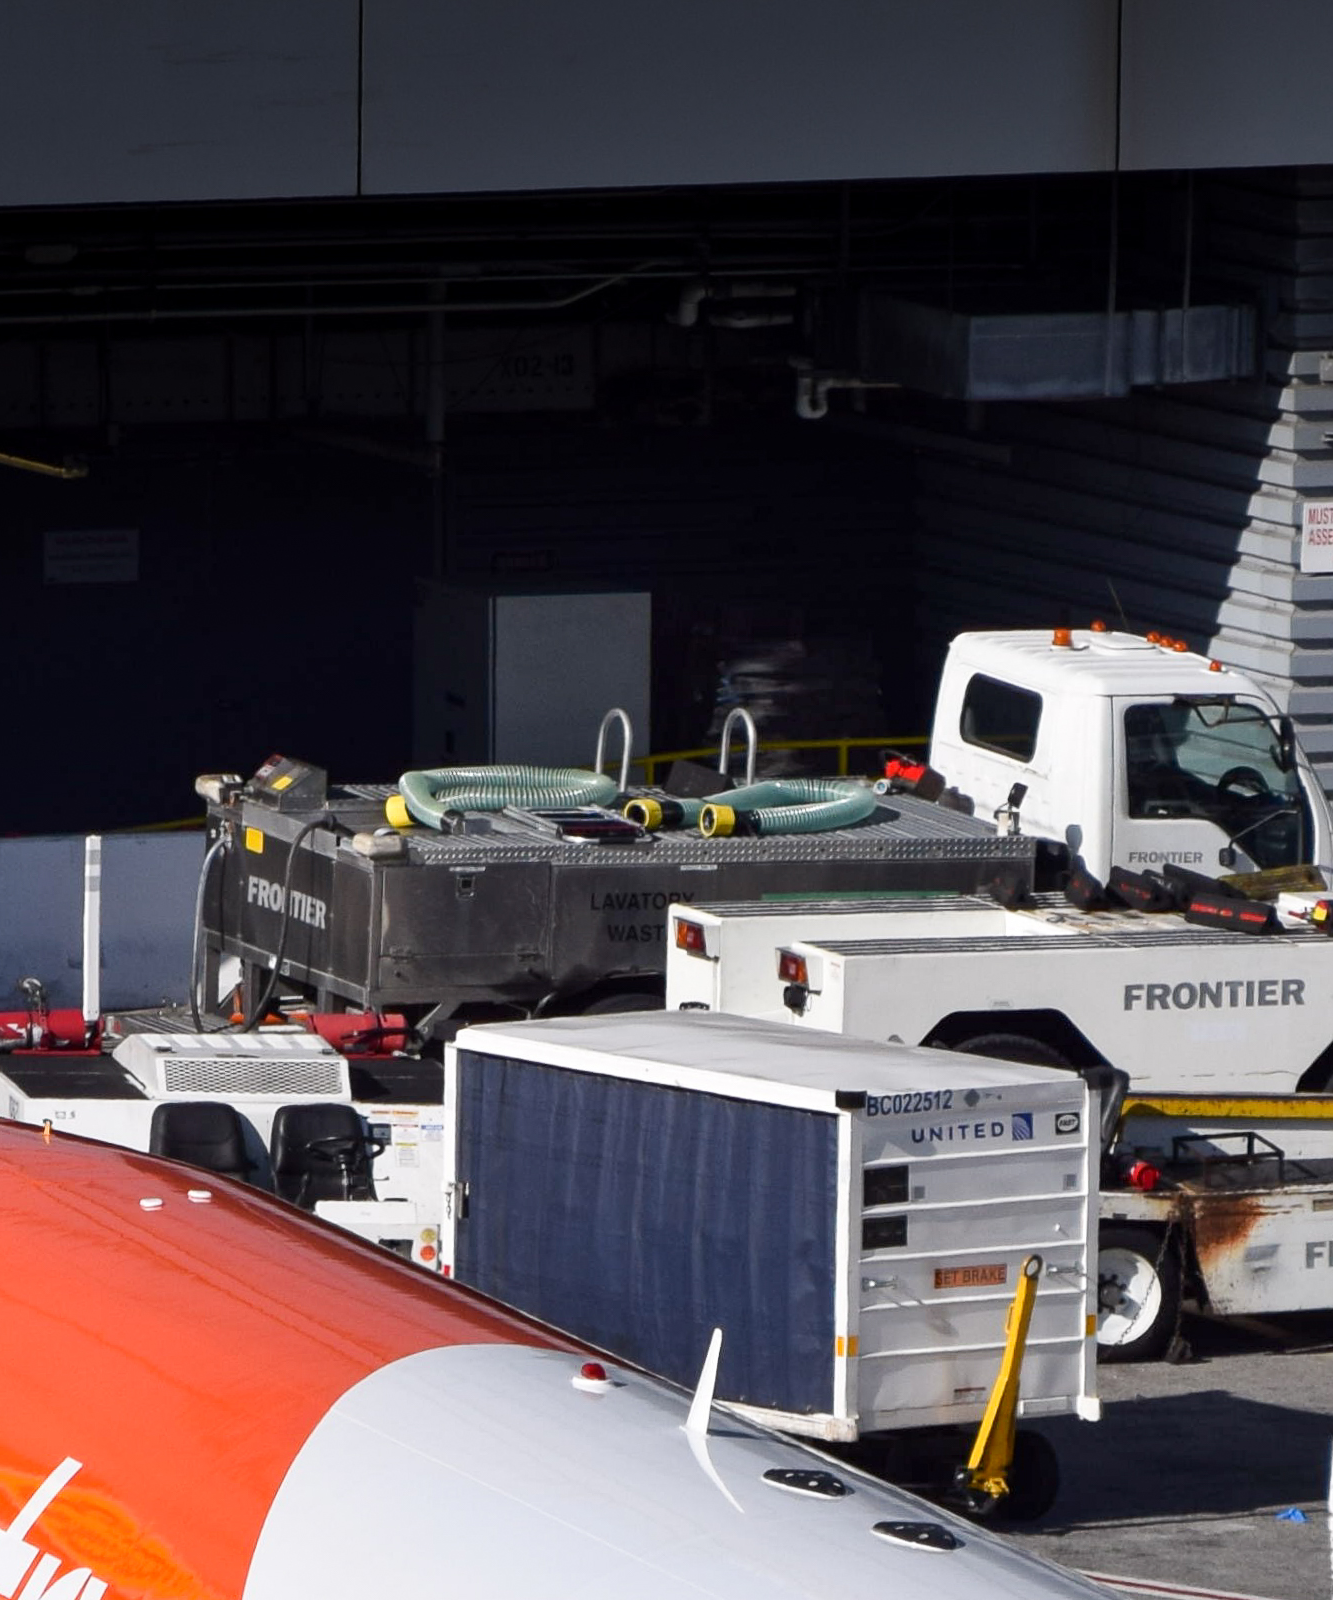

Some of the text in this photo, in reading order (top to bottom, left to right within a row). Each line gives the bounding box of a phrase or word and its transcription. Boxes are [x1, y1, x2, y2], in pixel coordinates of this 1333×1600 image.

[1128, 851, 1204, 864] FRONTIER
[247, 875, 327, 929] FRONTIER
[591, 892, 695, 910] LAVATORY
[1124, 979, 1306, 1011] FRONTIER
[867, 1090, 954, 1117] BC022512
[911, 1122, 1005, 1143] UNITED
[935, 1267, 1006, 1286] SET BRAKE
